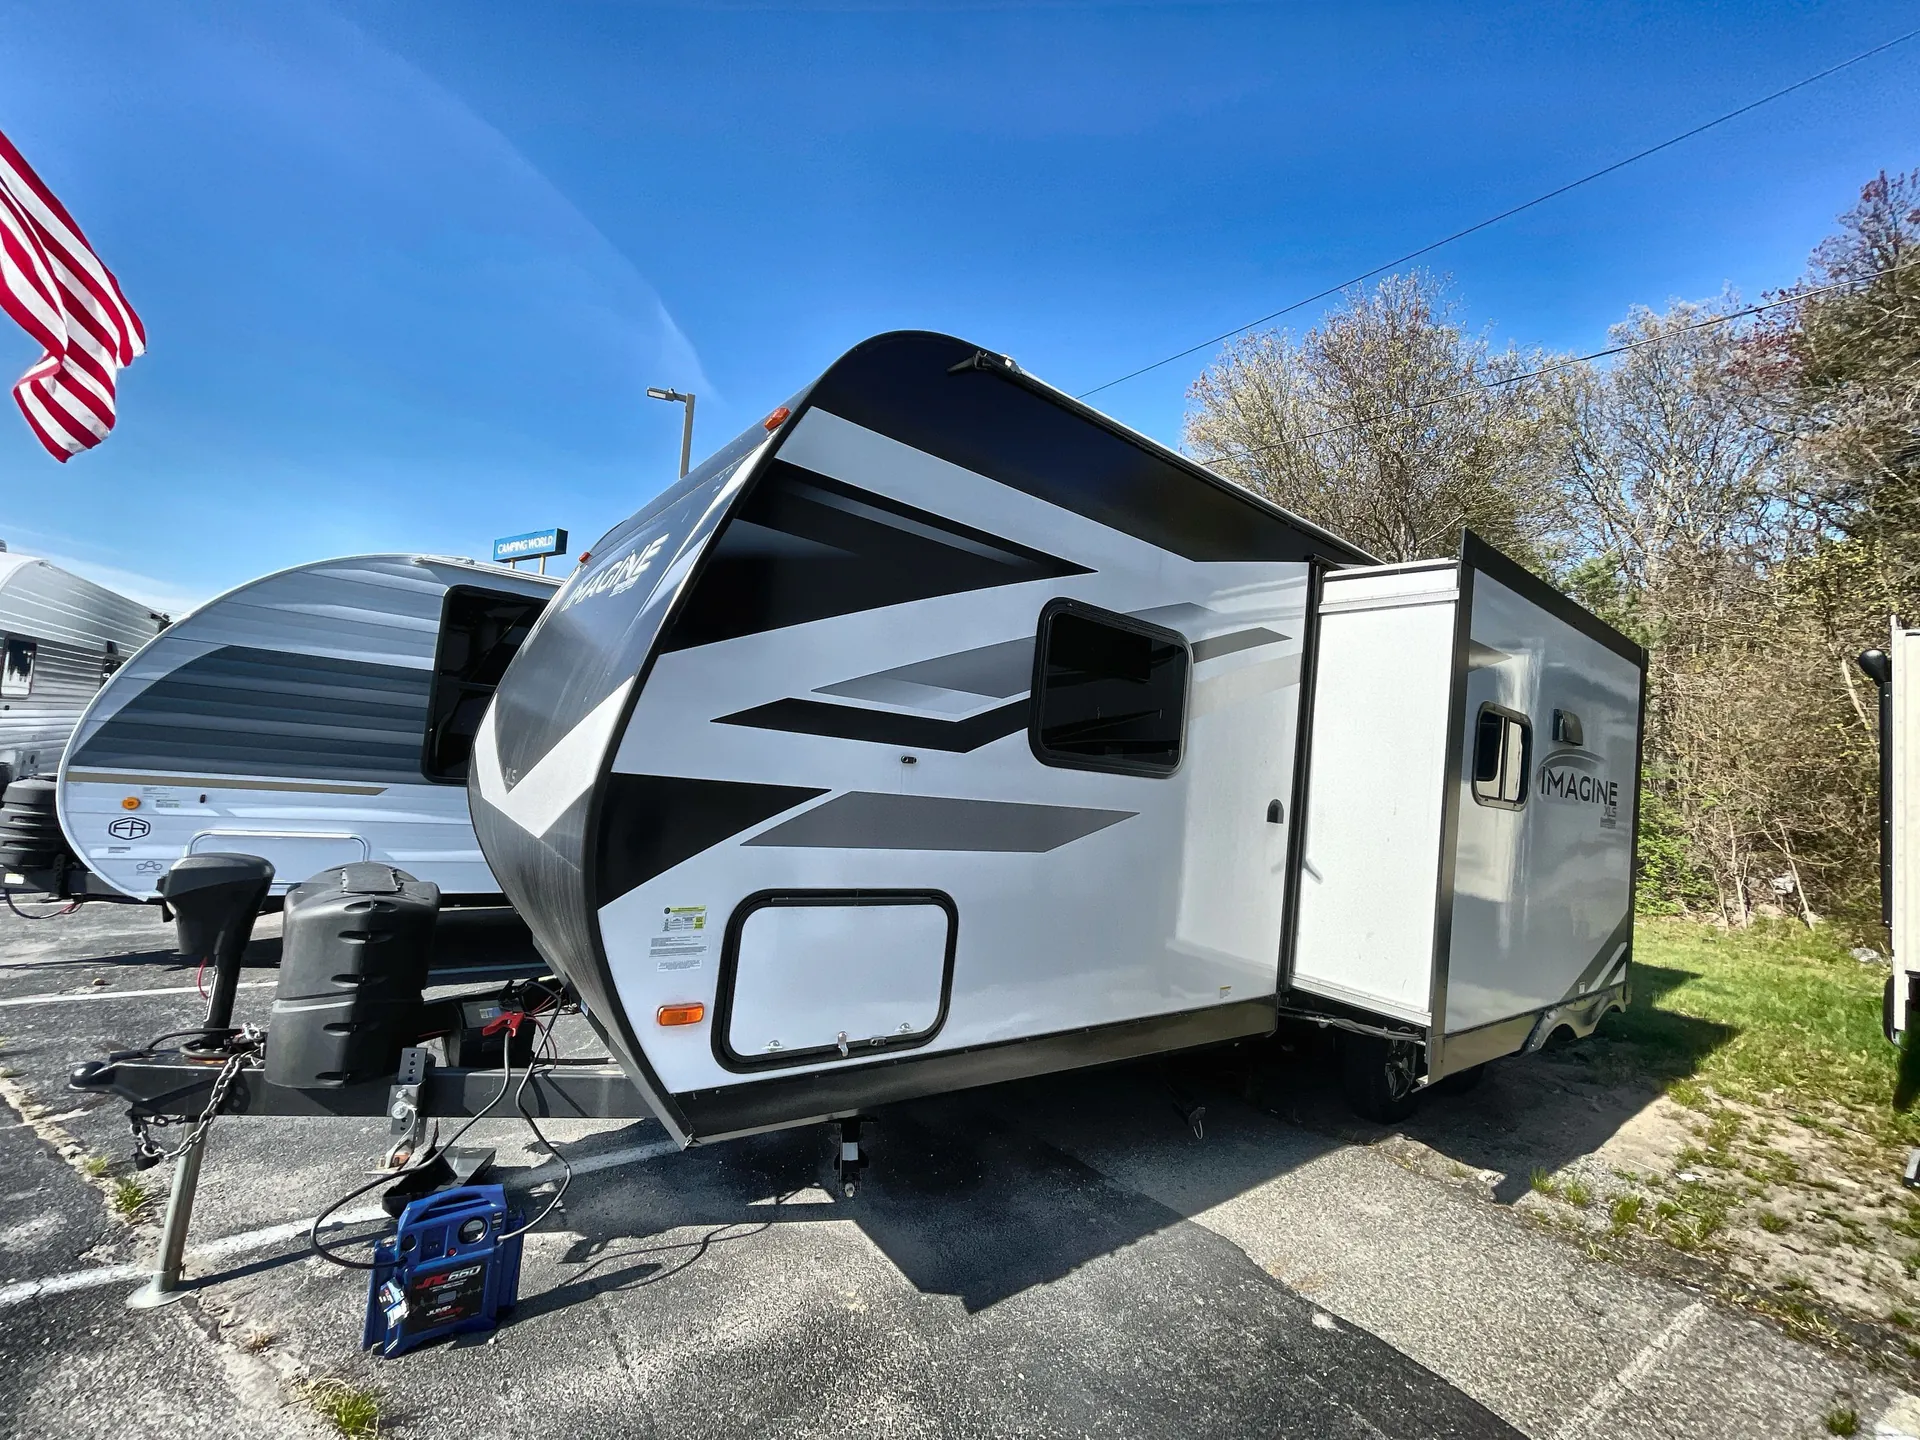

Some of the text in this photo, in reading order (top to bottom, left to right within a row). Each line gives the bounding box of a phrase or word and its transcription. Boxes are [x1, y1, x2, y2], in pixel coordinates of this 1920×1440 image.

[498, 535, 554, 554] CAMPING WORLD
[561, 533, 669, 611] IMAGINE
[1541, 767, 1618, 806] IMAGINE
